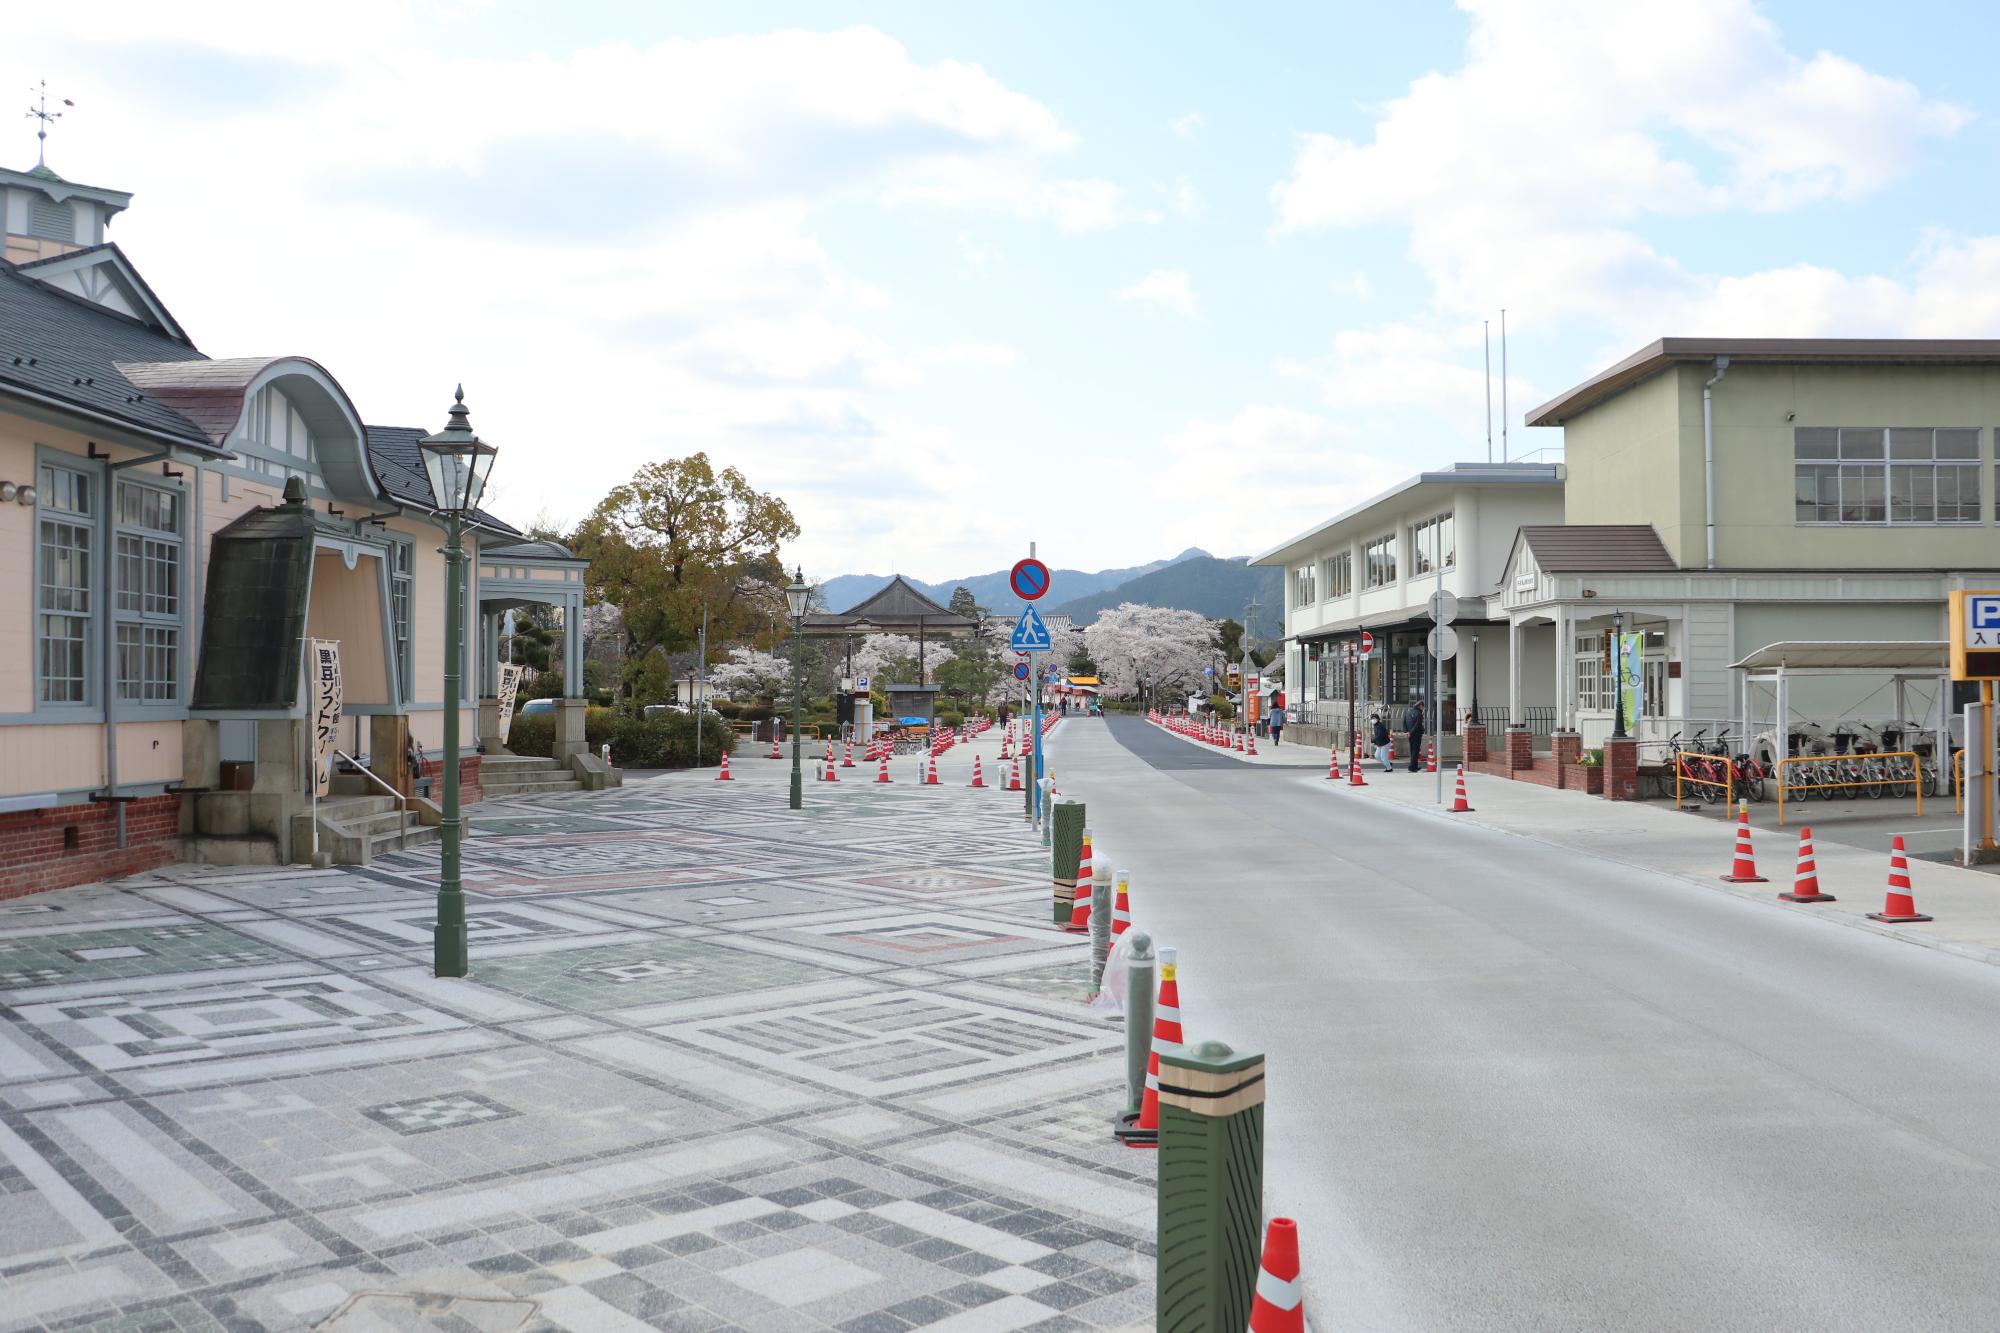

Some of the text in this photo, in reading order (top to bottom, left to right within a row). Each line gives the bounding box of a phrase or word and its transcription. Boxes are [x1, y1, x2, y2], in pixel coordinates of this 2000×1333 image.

[1977, 600, 2000, 627] P
[1974, 632, 2000, 645] 入
[317, 649, 334, 784] 黒豆ソフトクリム
